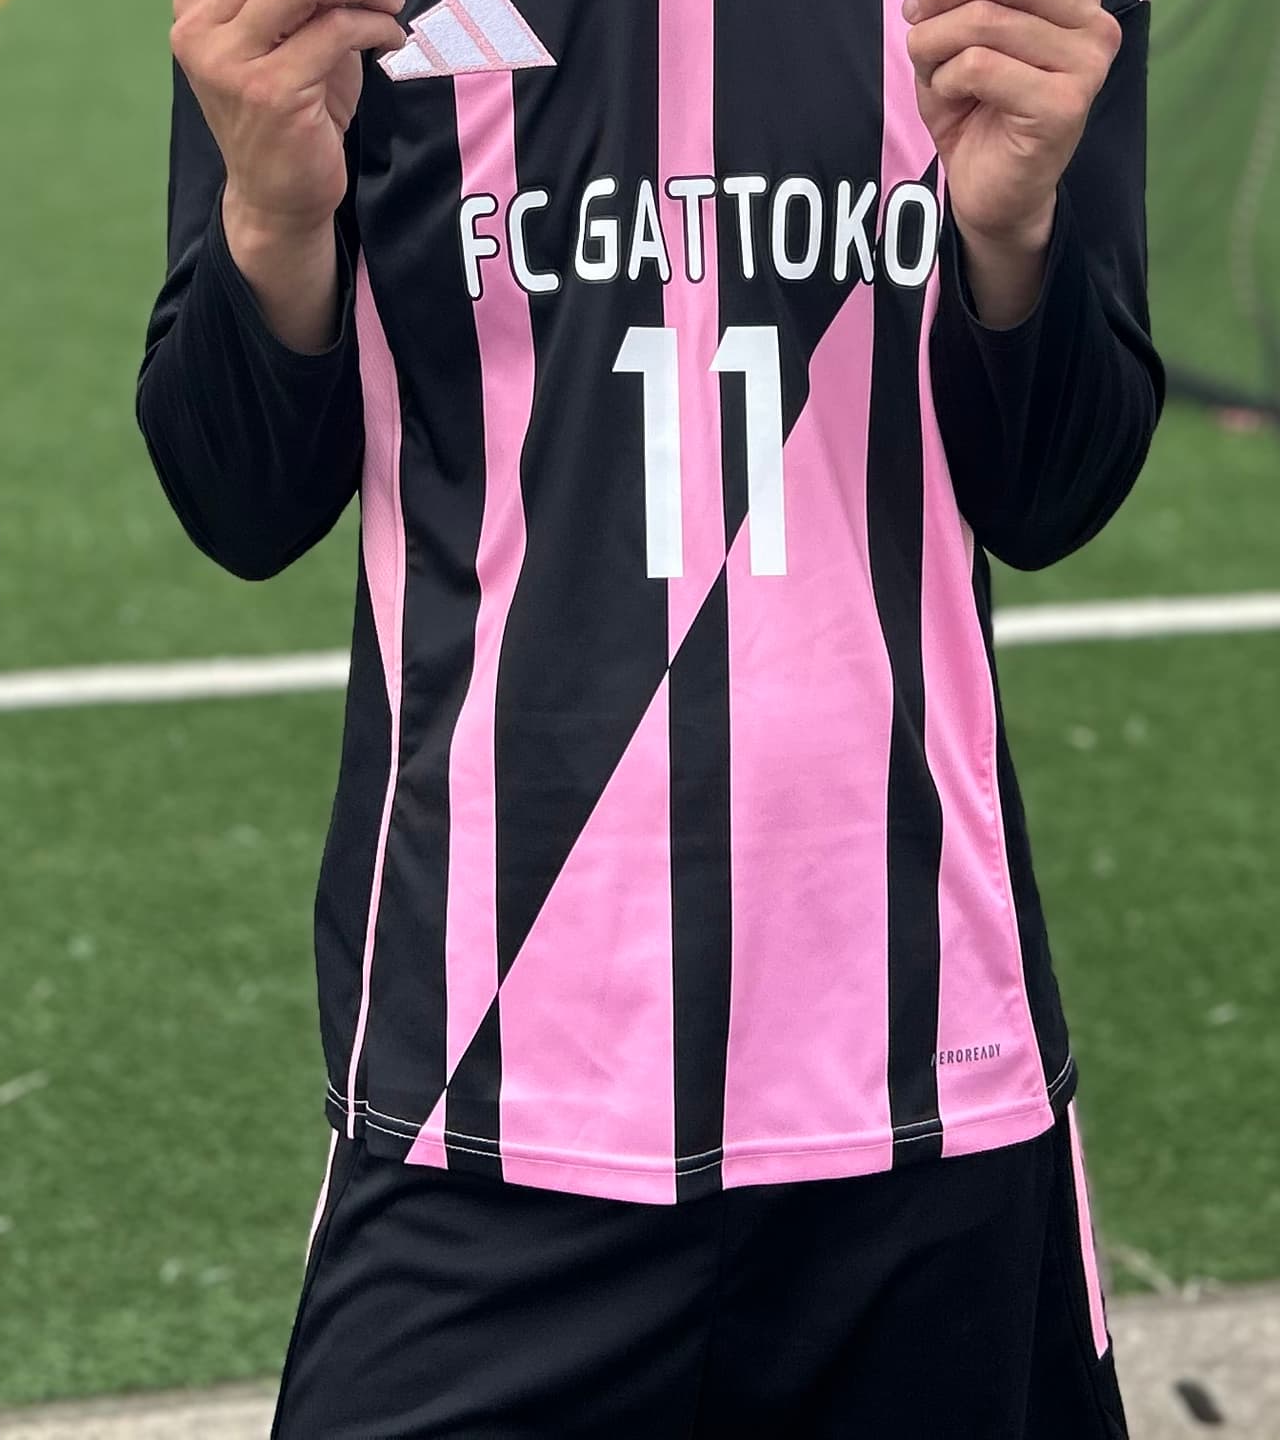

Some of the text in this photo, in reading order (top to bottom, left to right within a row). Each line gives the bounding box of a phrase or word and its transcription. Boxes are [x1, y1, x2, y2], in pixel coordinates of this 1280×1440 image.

[460, 176, 939, 298] FC GATTOKO
[611, 325, 788, 579] 11
